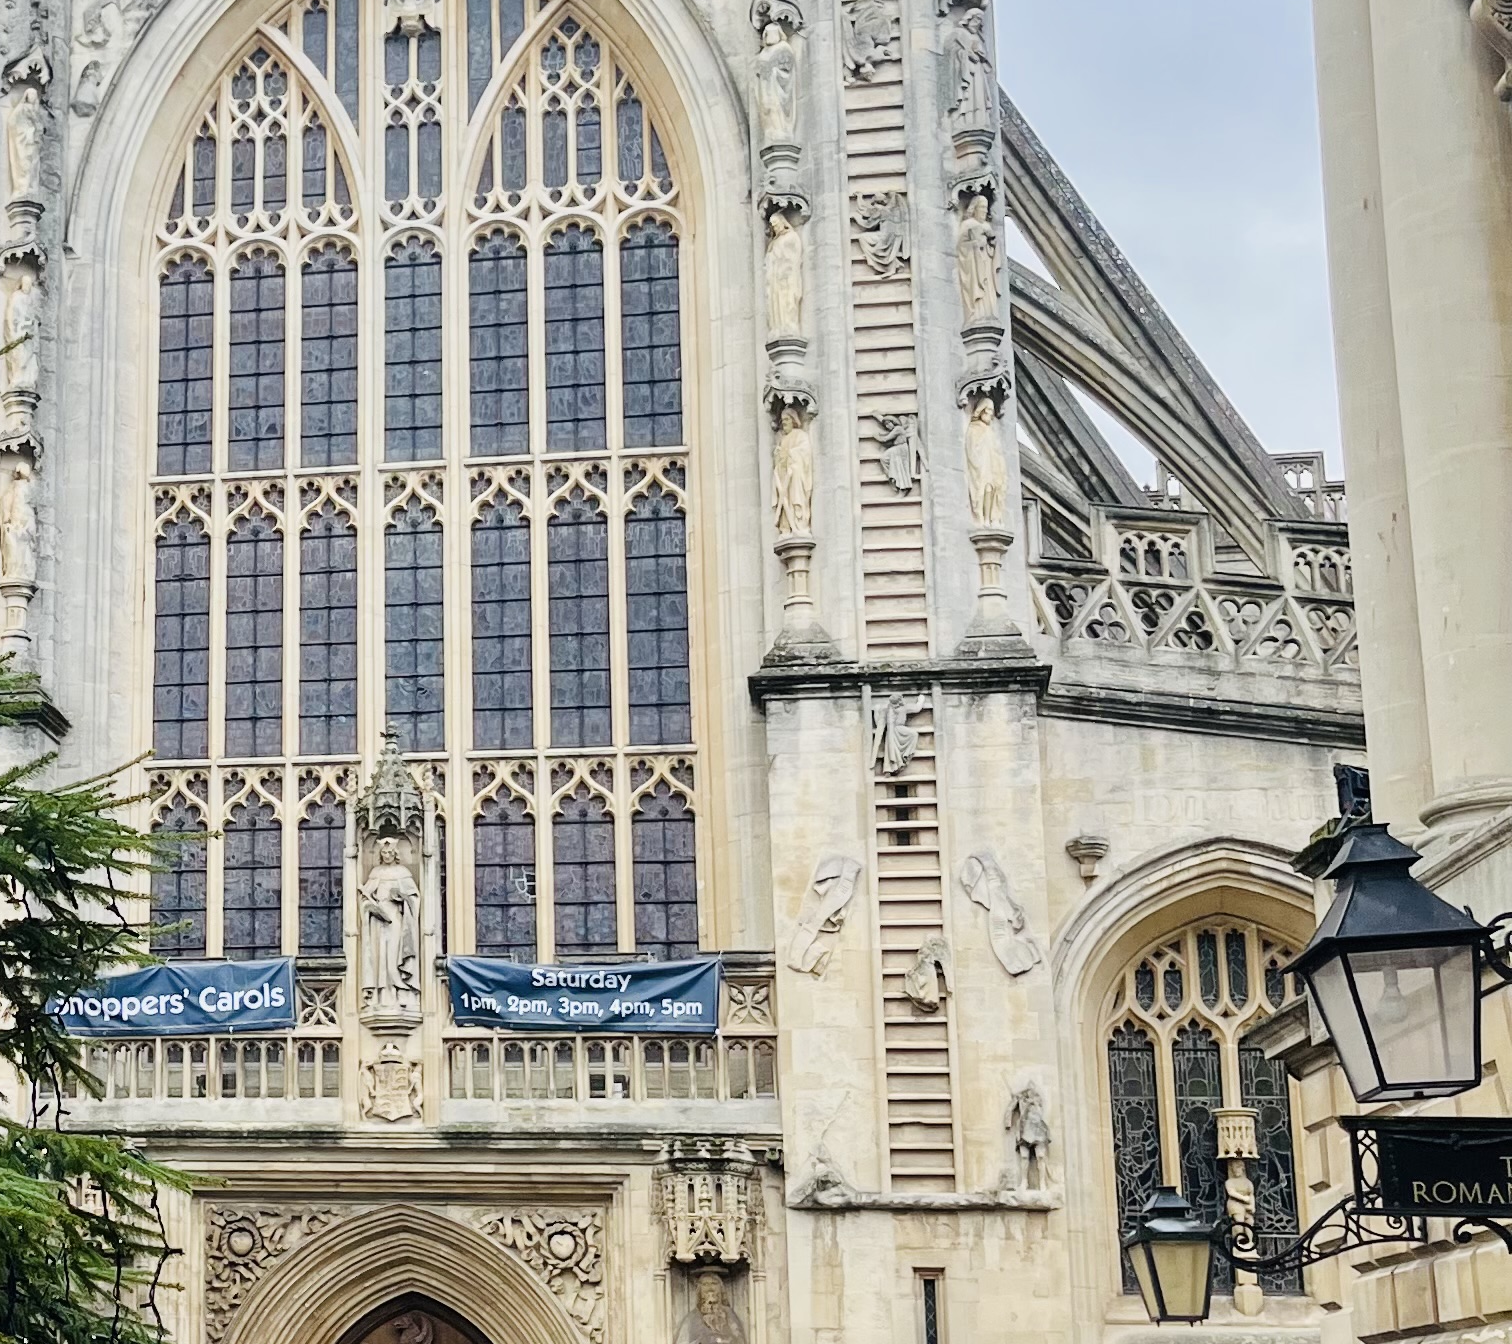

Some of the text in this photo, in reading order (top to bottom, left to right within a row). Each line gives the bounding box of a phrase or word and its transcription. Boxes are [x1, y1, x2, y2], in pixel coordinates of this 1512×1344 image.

[531, 968, 632, 992] Saturday
[198, 982, 286, 1013] Carols
[460, 992, 703, 1019] 1pm, 2pm, 3pm, 4pm, 5pm
